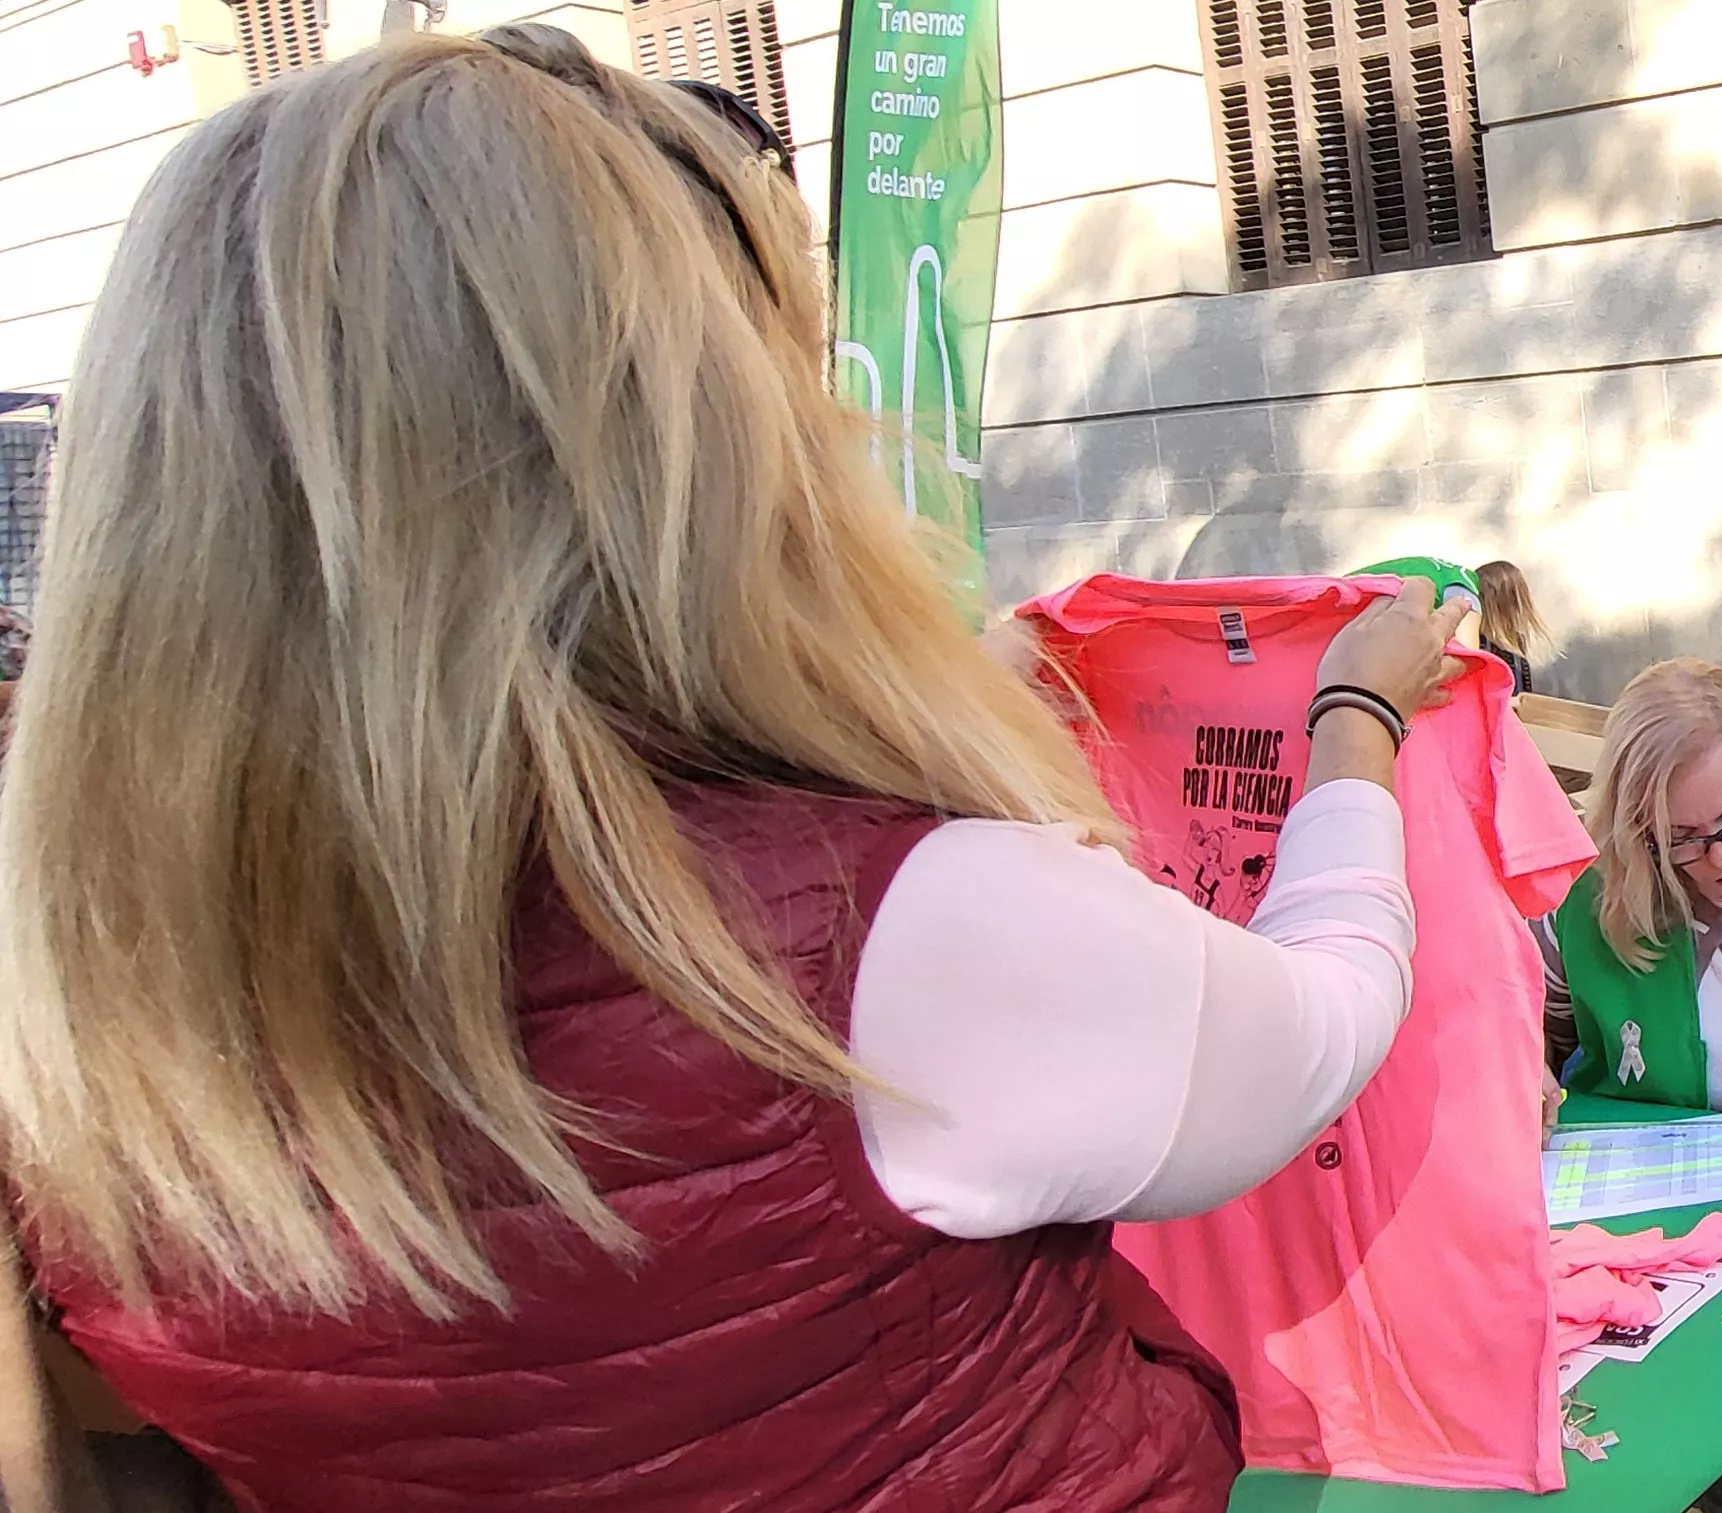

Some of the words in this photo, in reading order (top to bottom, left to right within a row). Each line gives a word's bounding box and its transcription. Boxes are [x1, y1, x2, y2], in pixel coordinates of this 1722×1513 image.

[877, 2, 966, 37] Tenemos
[874, 50, 897, 74] un
[903, 53, 947, 83] gran
[871, 87, 940, 119] camino
[868, 131, 904, 161] por
[867, 165, 945, 200] delante
[1195, 725, 1284, 771] CORRAMOS
[1183, 767, 1209, 808] POR
[1212, 769, 1229, 811] LA
[1232, 770, 1293, 818] CIENCIA
